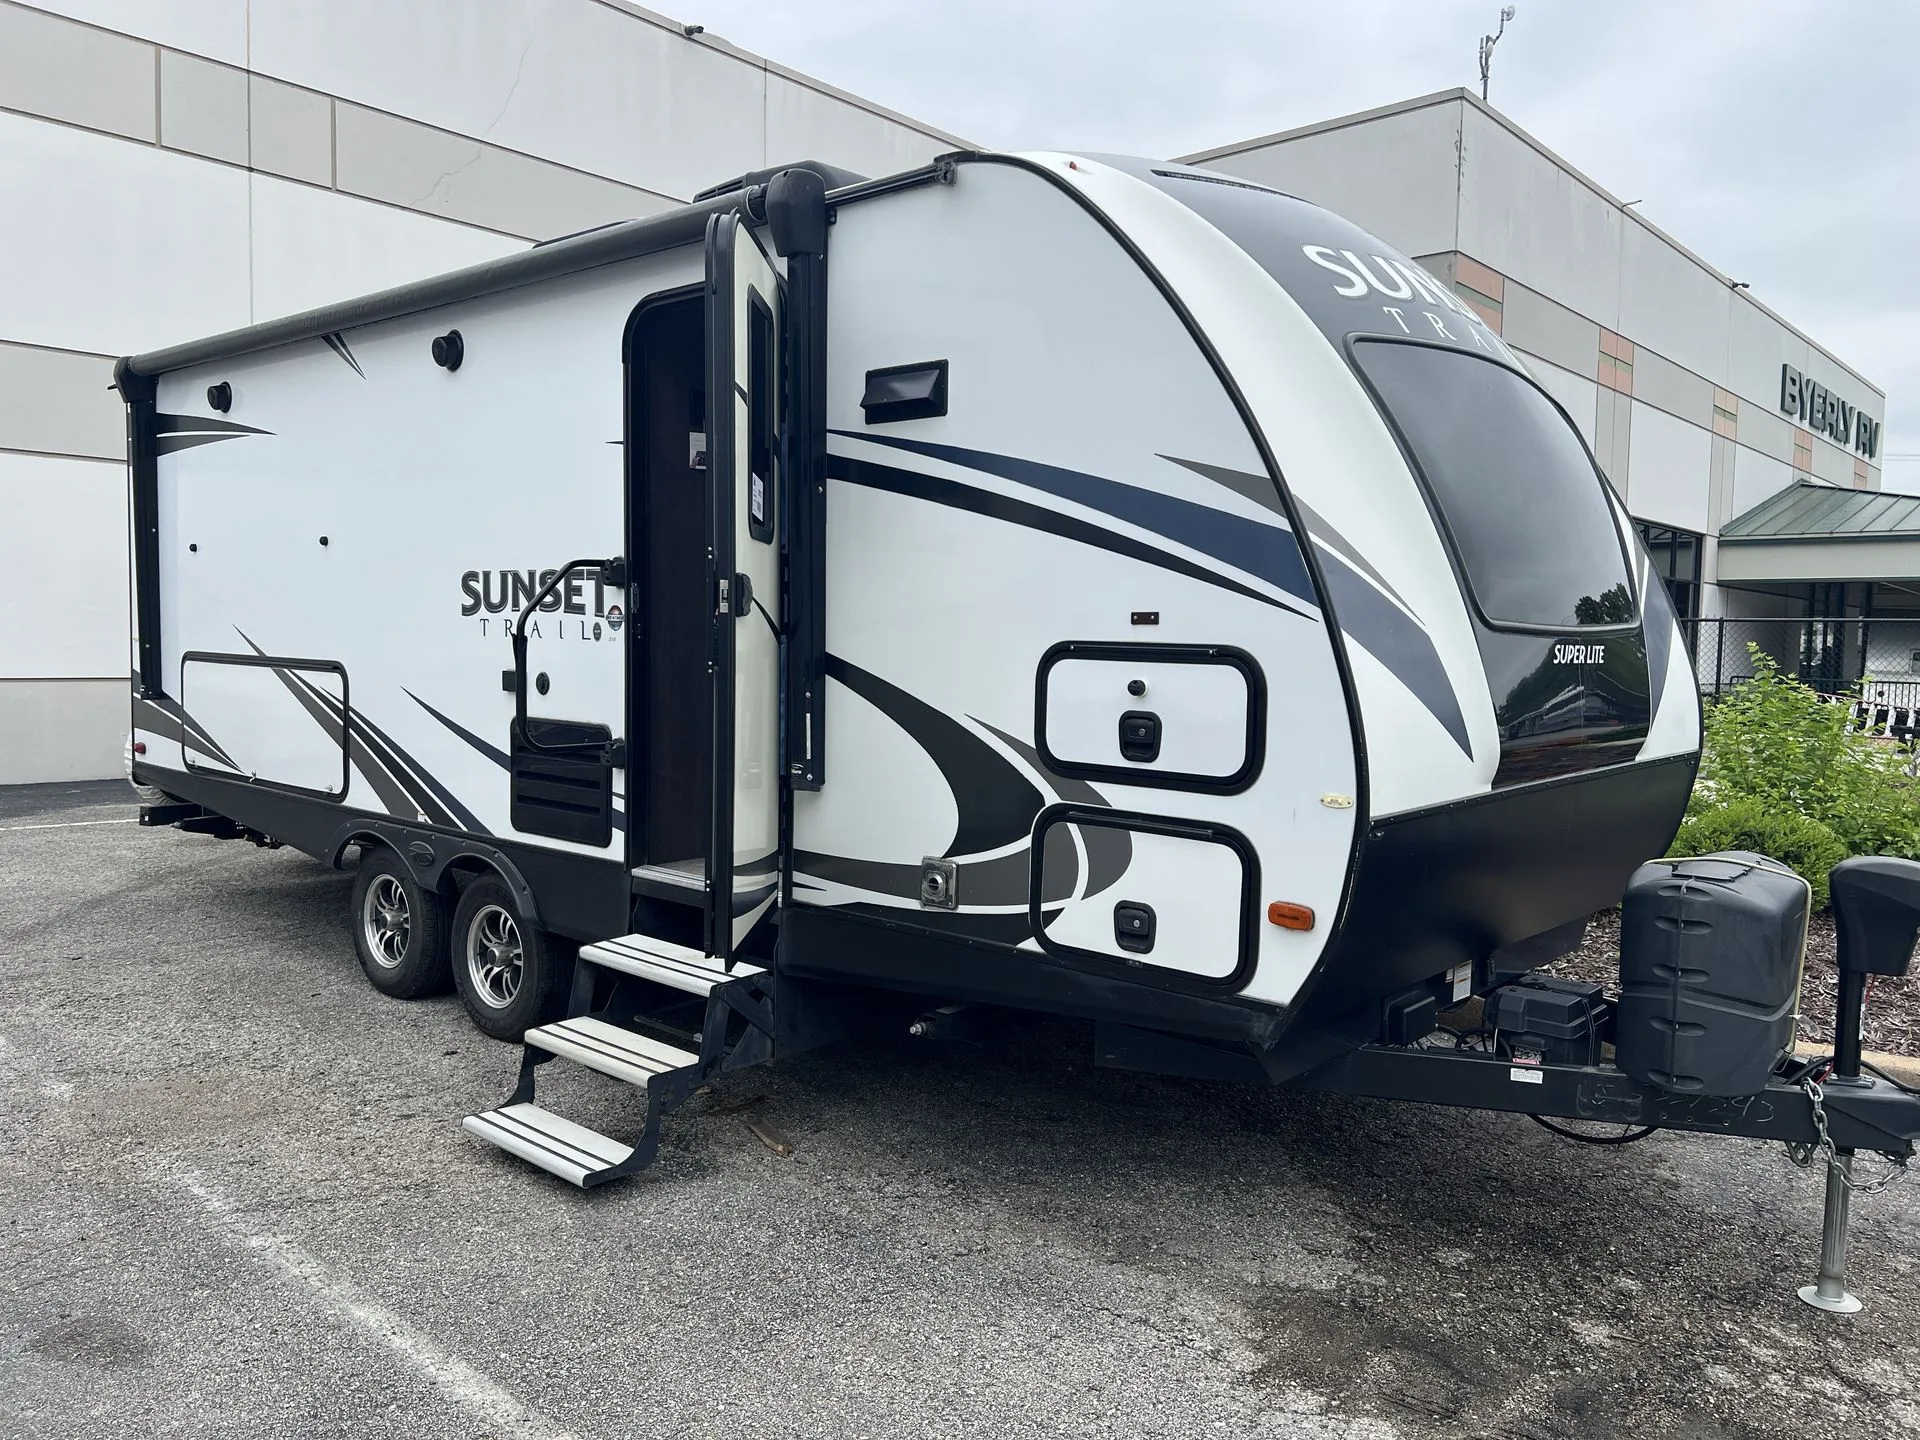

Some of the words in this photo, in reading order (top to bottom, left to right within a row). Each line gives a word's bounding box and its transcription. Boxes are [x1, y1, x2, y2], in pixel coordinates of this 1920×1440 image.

[1780, 363, 1857, 445] BYERLY
[1855, 411, 1881, 459] RV
[461, 569, 605, 618] SUNSET
[479, 618, 591, 640] TRAIL
[1553, 644, 1586, 664] SUPER
[1586, 645, 1605, 664] LITE
